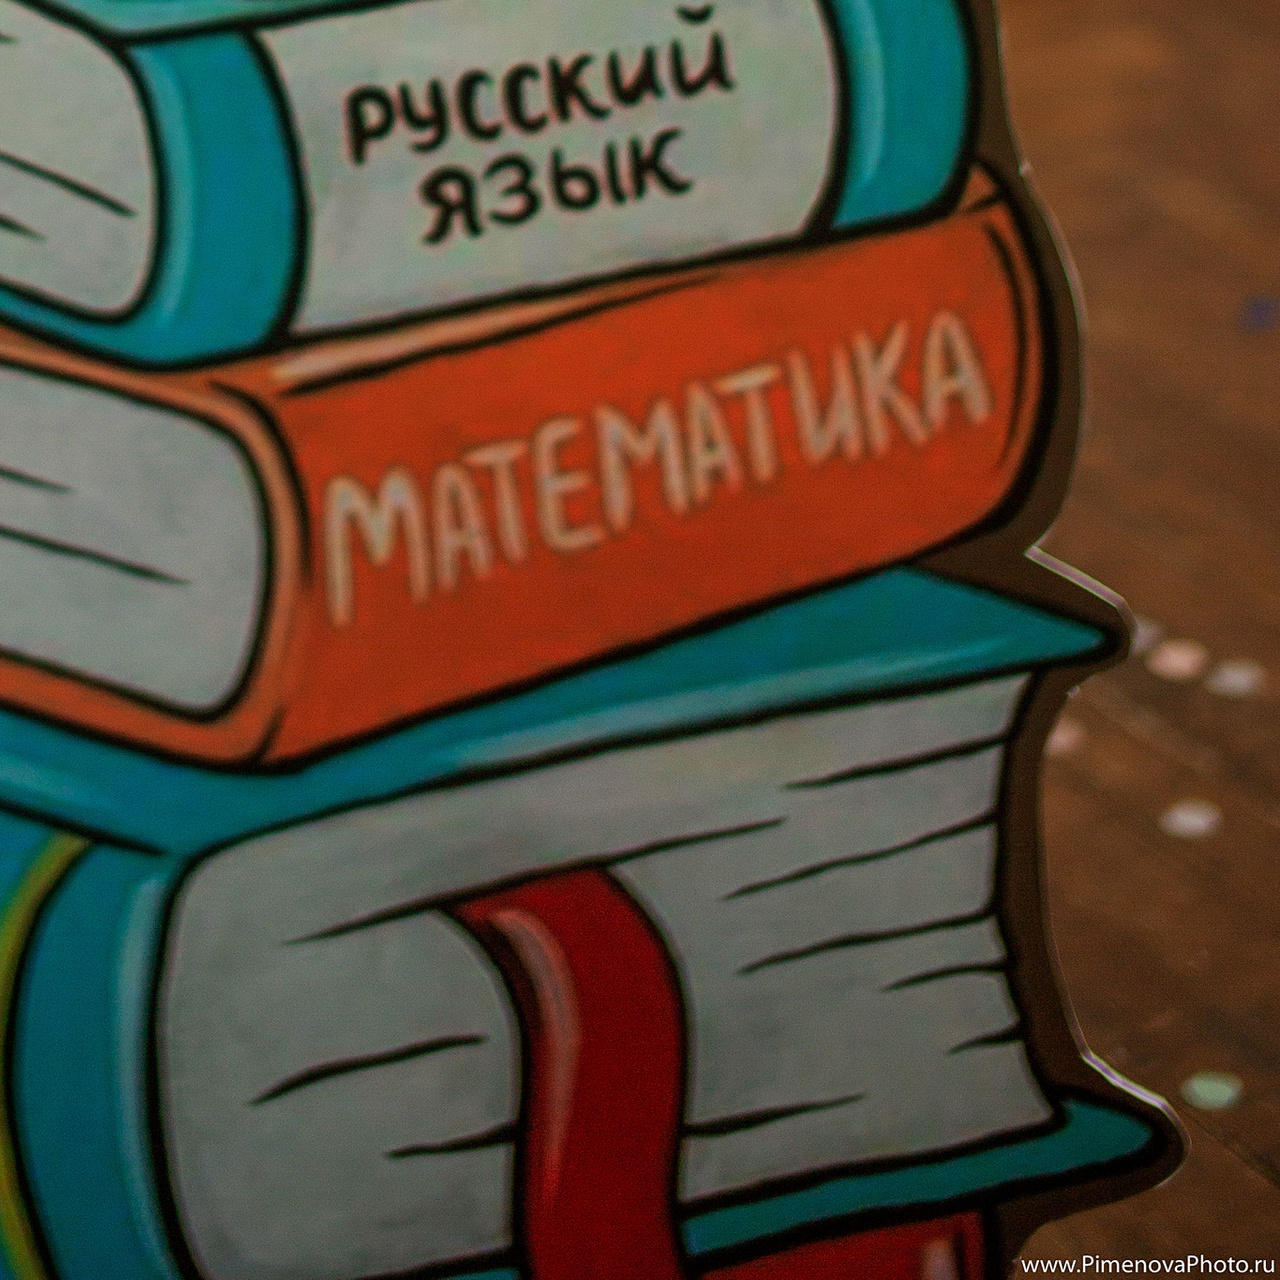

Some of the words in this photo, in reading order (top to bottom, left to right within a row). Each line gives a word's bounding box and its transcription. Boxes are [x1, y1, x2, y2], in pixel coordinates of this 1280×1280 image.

[342, 3, 736, 164] РУССКИЙ
[419, 128, 693, 244] ЯЗЫК
[322, 309, 994, 627] МАТЕМАТИКА
